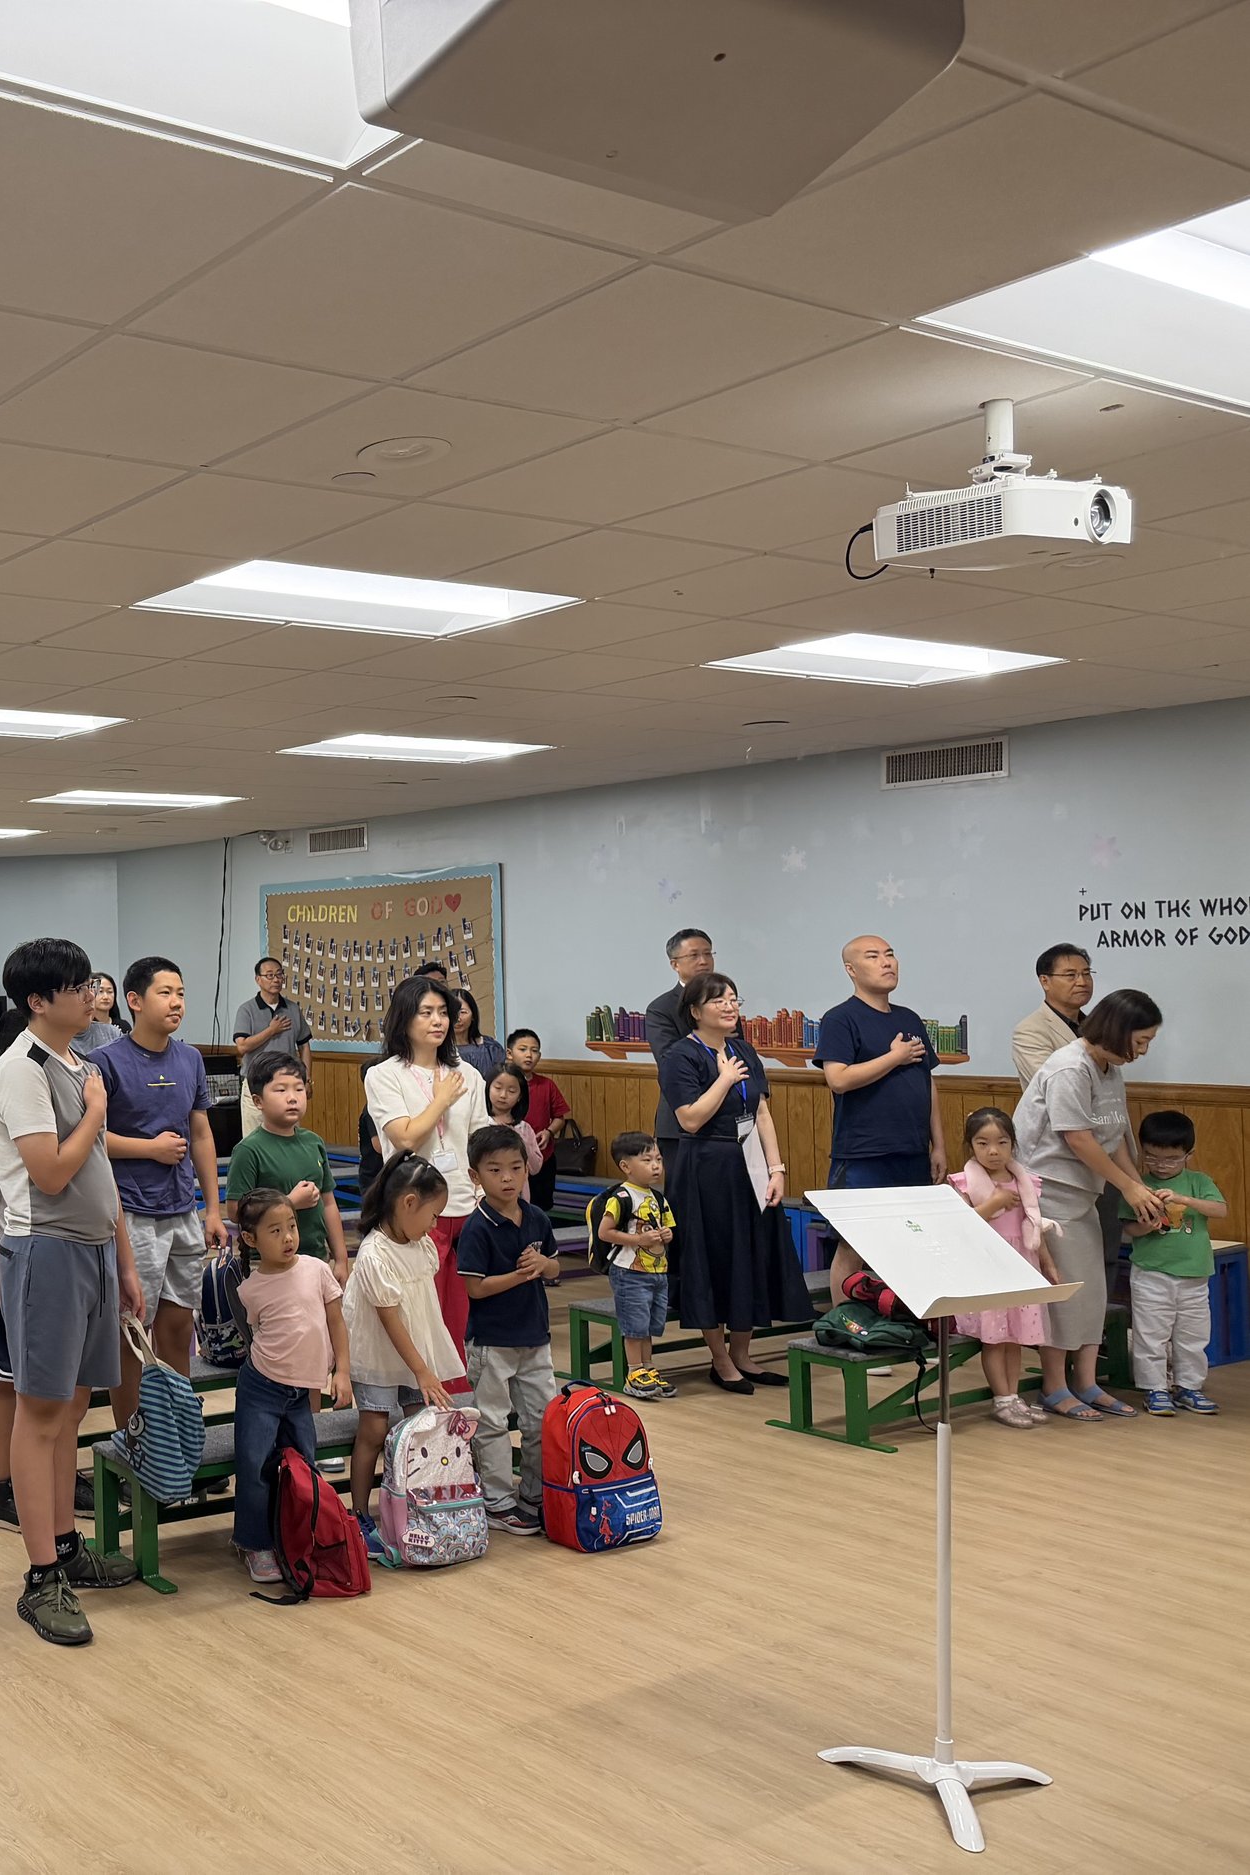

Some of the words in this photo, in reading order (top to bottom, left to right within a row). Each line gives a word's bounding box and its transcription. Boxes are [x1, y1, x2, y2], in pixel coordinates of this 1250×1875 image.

[287, 904, 359, 924] CHILDREN
[371, 901, 394, 921] OF
[404, 896, 443, 918] GOD
[1079, 903, 1113, 922] PUT
[1120, 901, 1146, 920] ON
[1154, 899, 1192, 919] THE
[1199, 896, 1250, 917] WHO
[1097, 928, 1167, 948] ARMOR
[1174, 927, 1199, 946] OF
[1208, 926, 1250, 946] GOD
[408, 1538, 430, 1546] KITTY
[409, 1533, 430, 1541] HELLO
